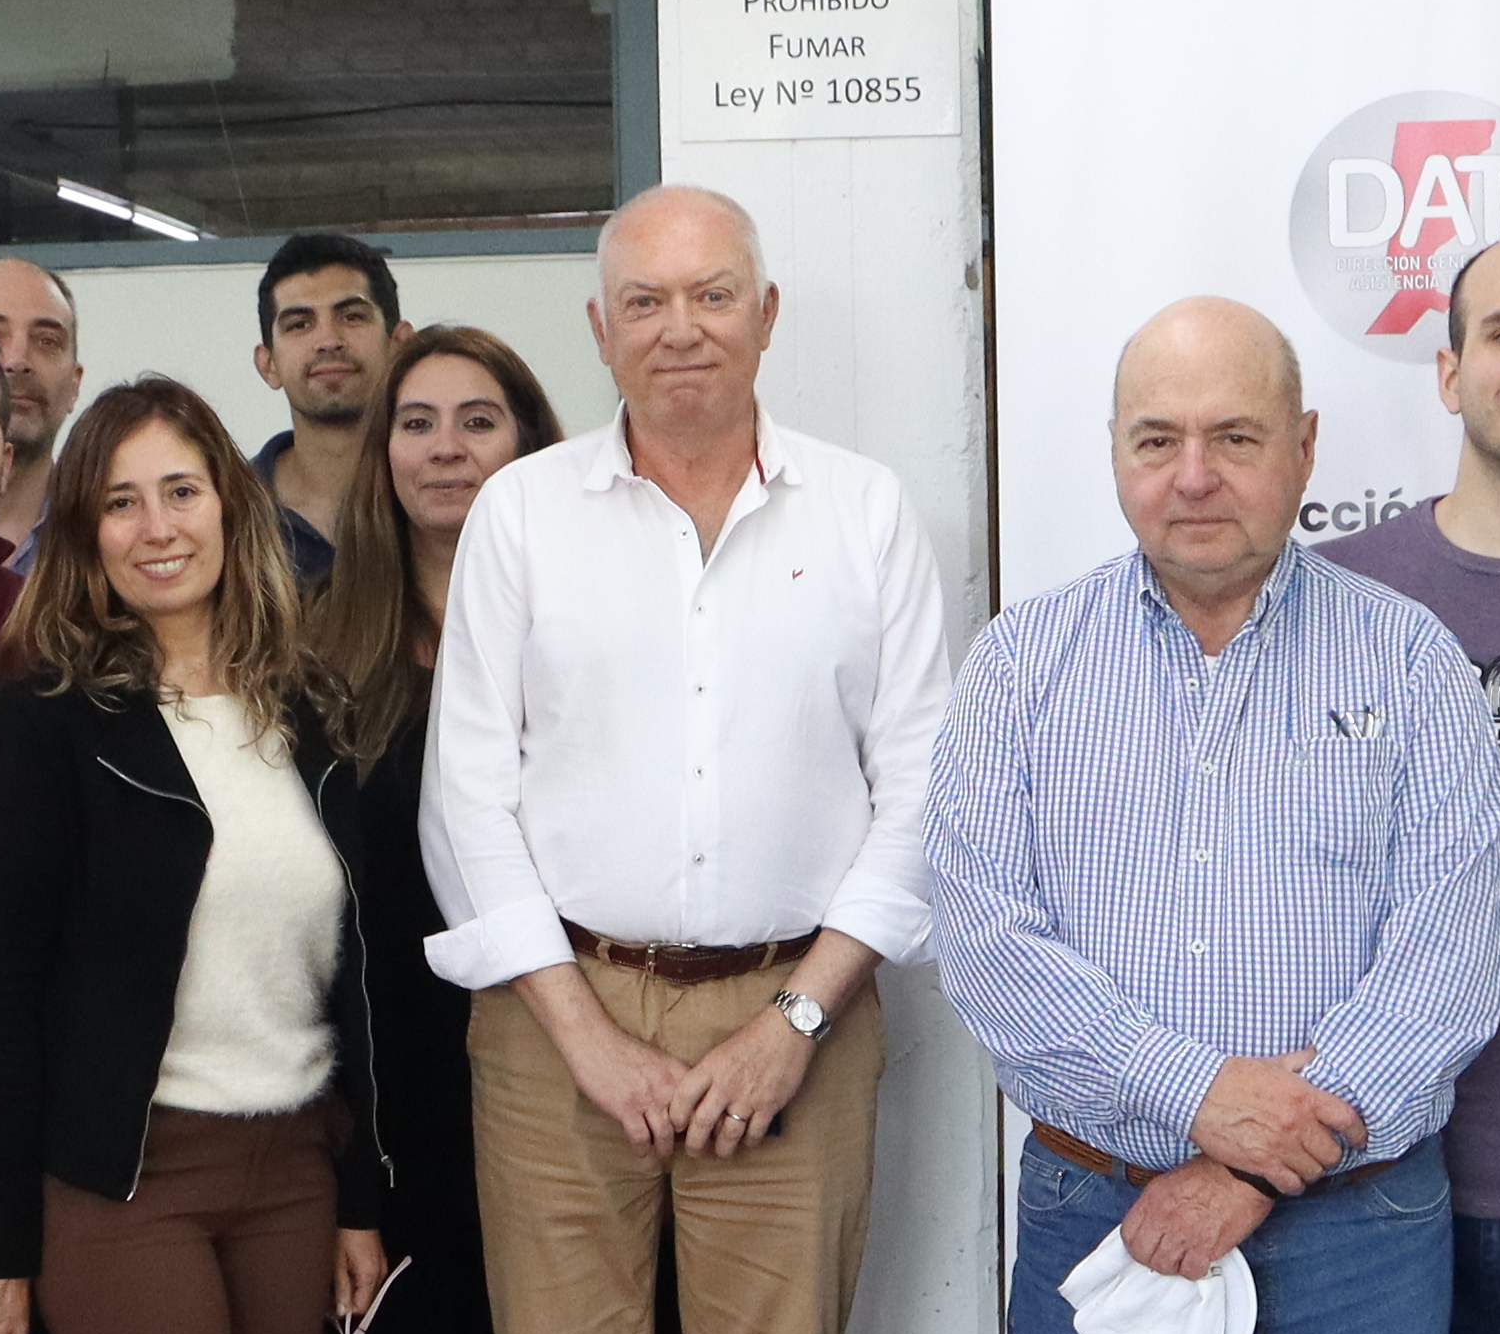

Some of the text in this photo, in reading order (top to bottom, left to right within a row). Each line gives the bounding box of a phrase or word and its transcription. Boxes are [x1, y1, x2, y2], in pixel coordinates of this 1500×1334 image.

[768, 33, 866, 59] FUMAR
[714, 81, 765, 113] Ley
[826, 76, 922, 104] 10855
